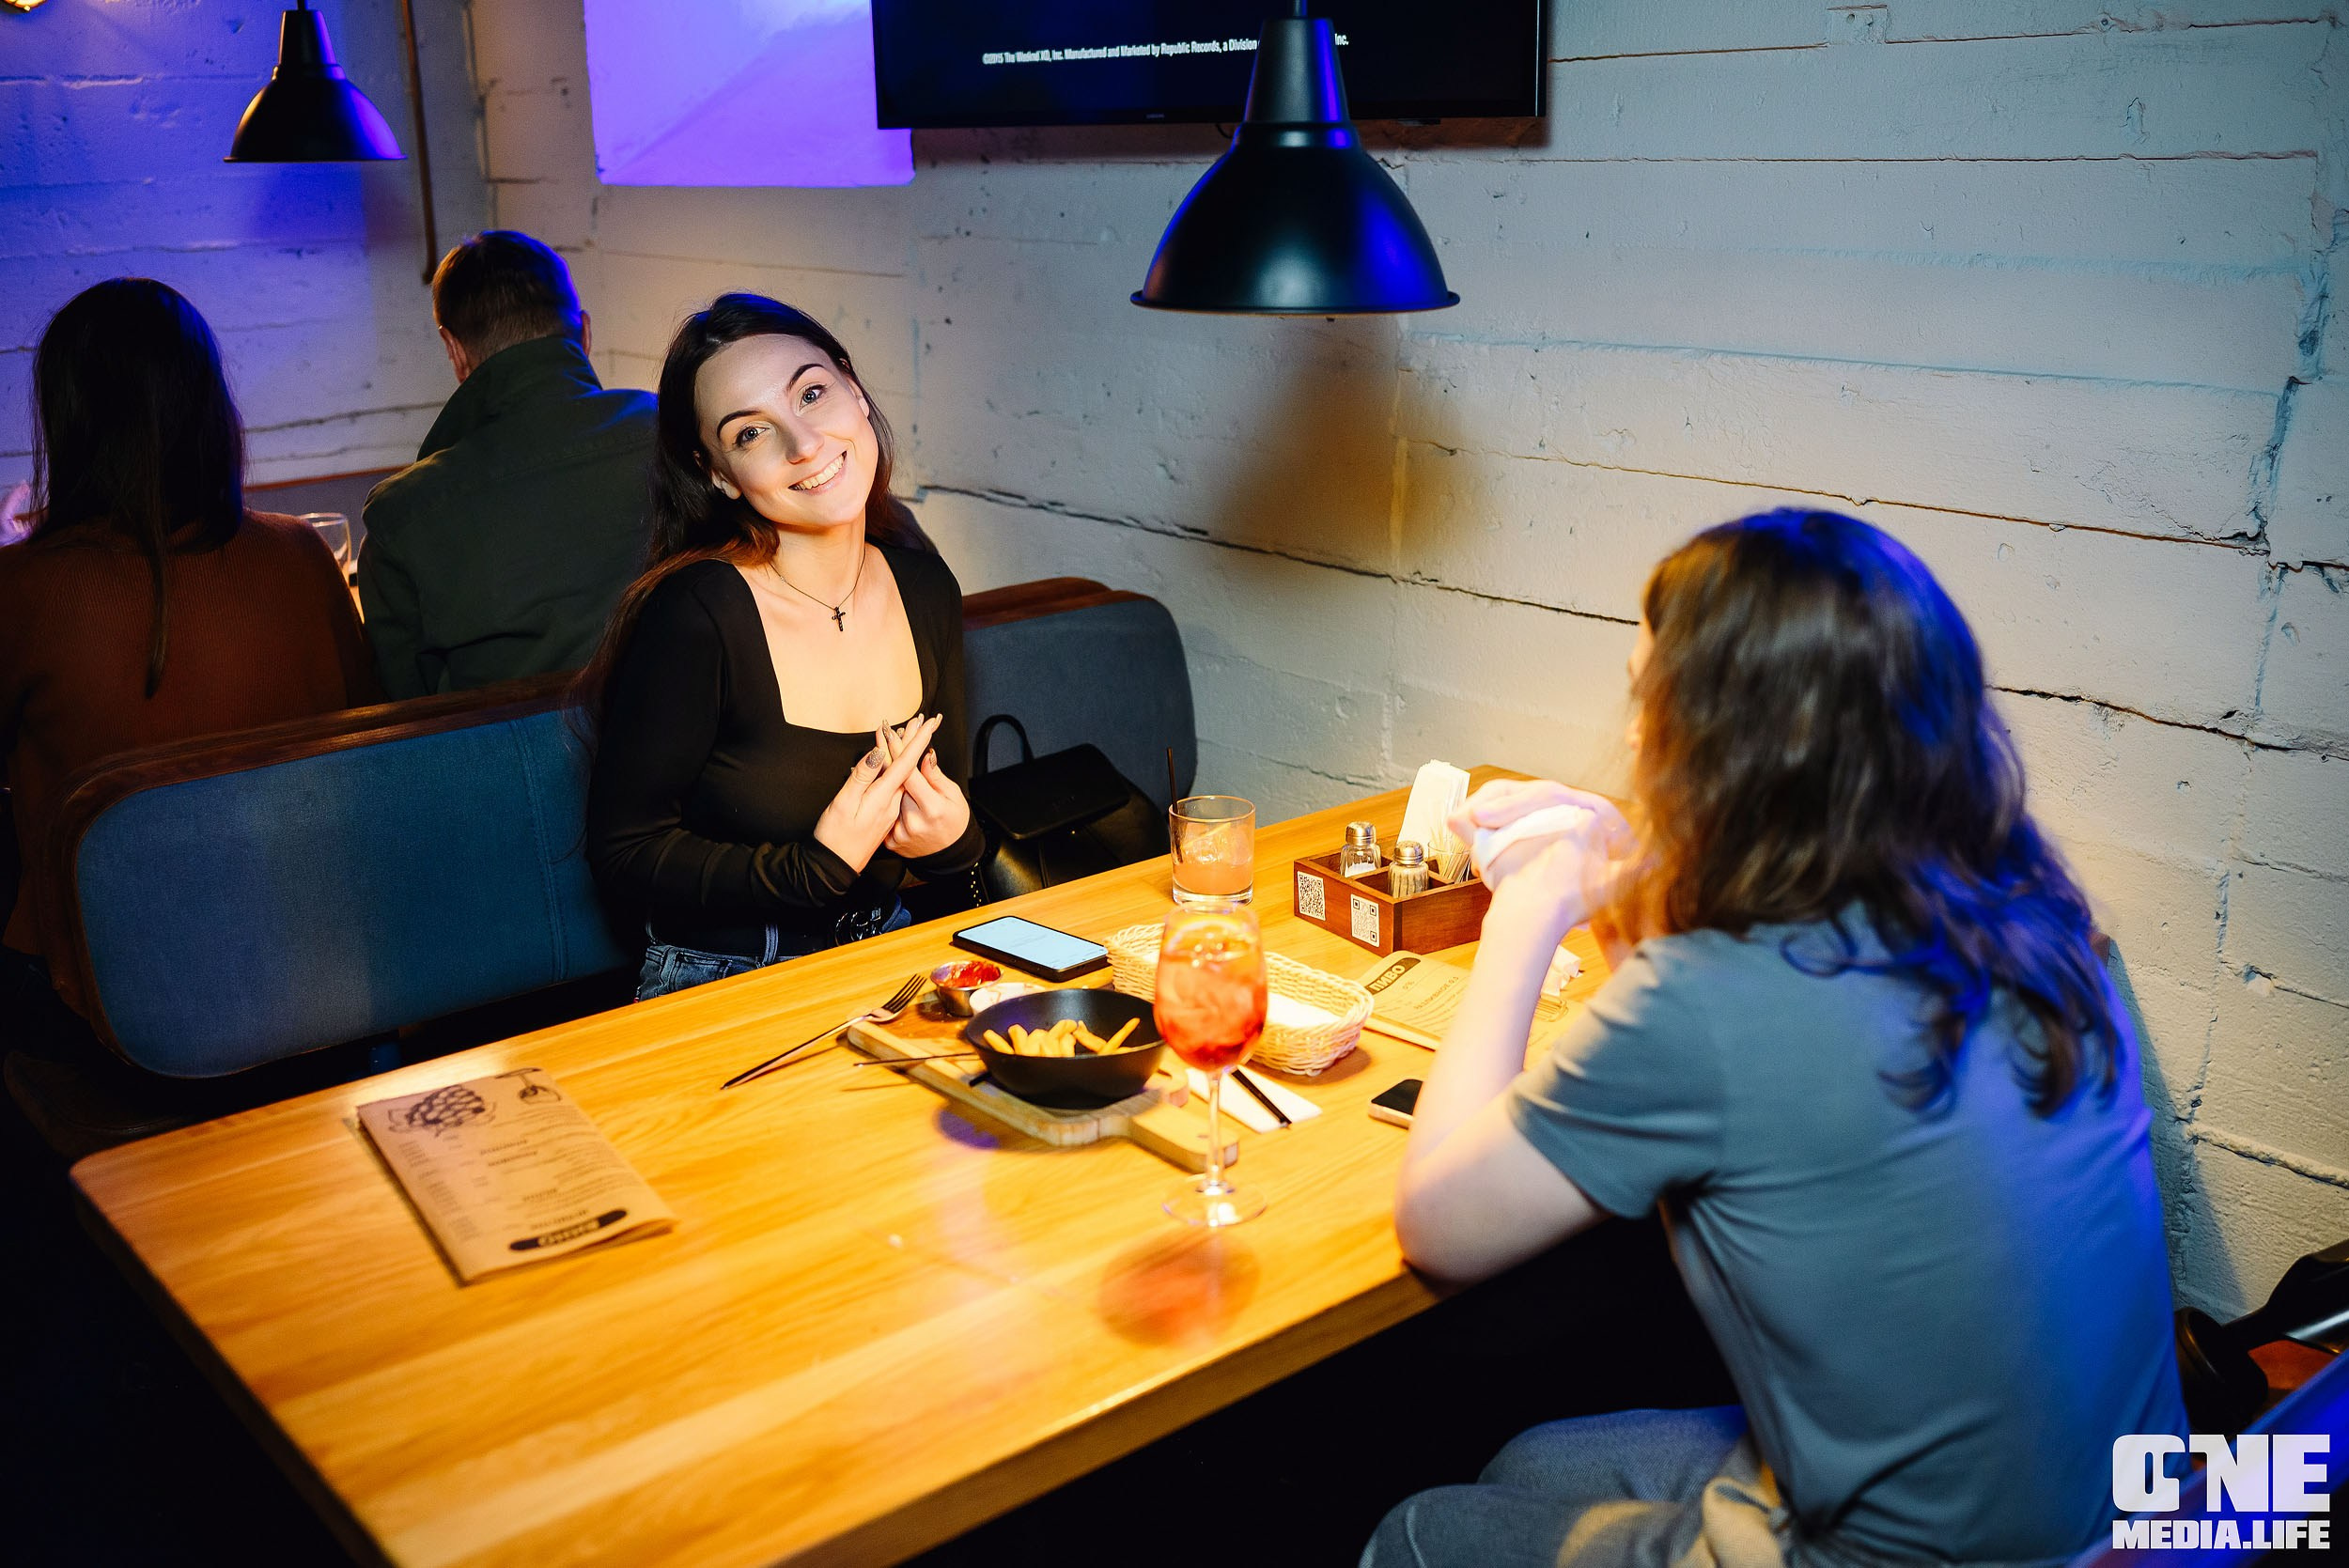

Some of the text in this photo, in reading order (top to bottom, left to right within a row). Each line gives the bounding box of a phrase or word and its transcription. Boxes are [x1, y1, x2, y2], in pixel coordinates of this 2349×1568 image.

[1051, 49, 1064, 60] Inc.
[1064, 47, 1107, 59] Manufactured
[1108, 46, 1120, 57] and
[1120, 44, 1151, 56] Marketed
[1151, 43, 1160, 57] by
[1160, 41, 1190, 56] Republic
[1190, 39, 1222, 54] Records,
[1222, 42, 1228, 51] a
[1228, 39, 1257, 52] Division
[1334, 33, 1349, 45] Inc.
[1368, 965, 1406, 991] ПИВО
